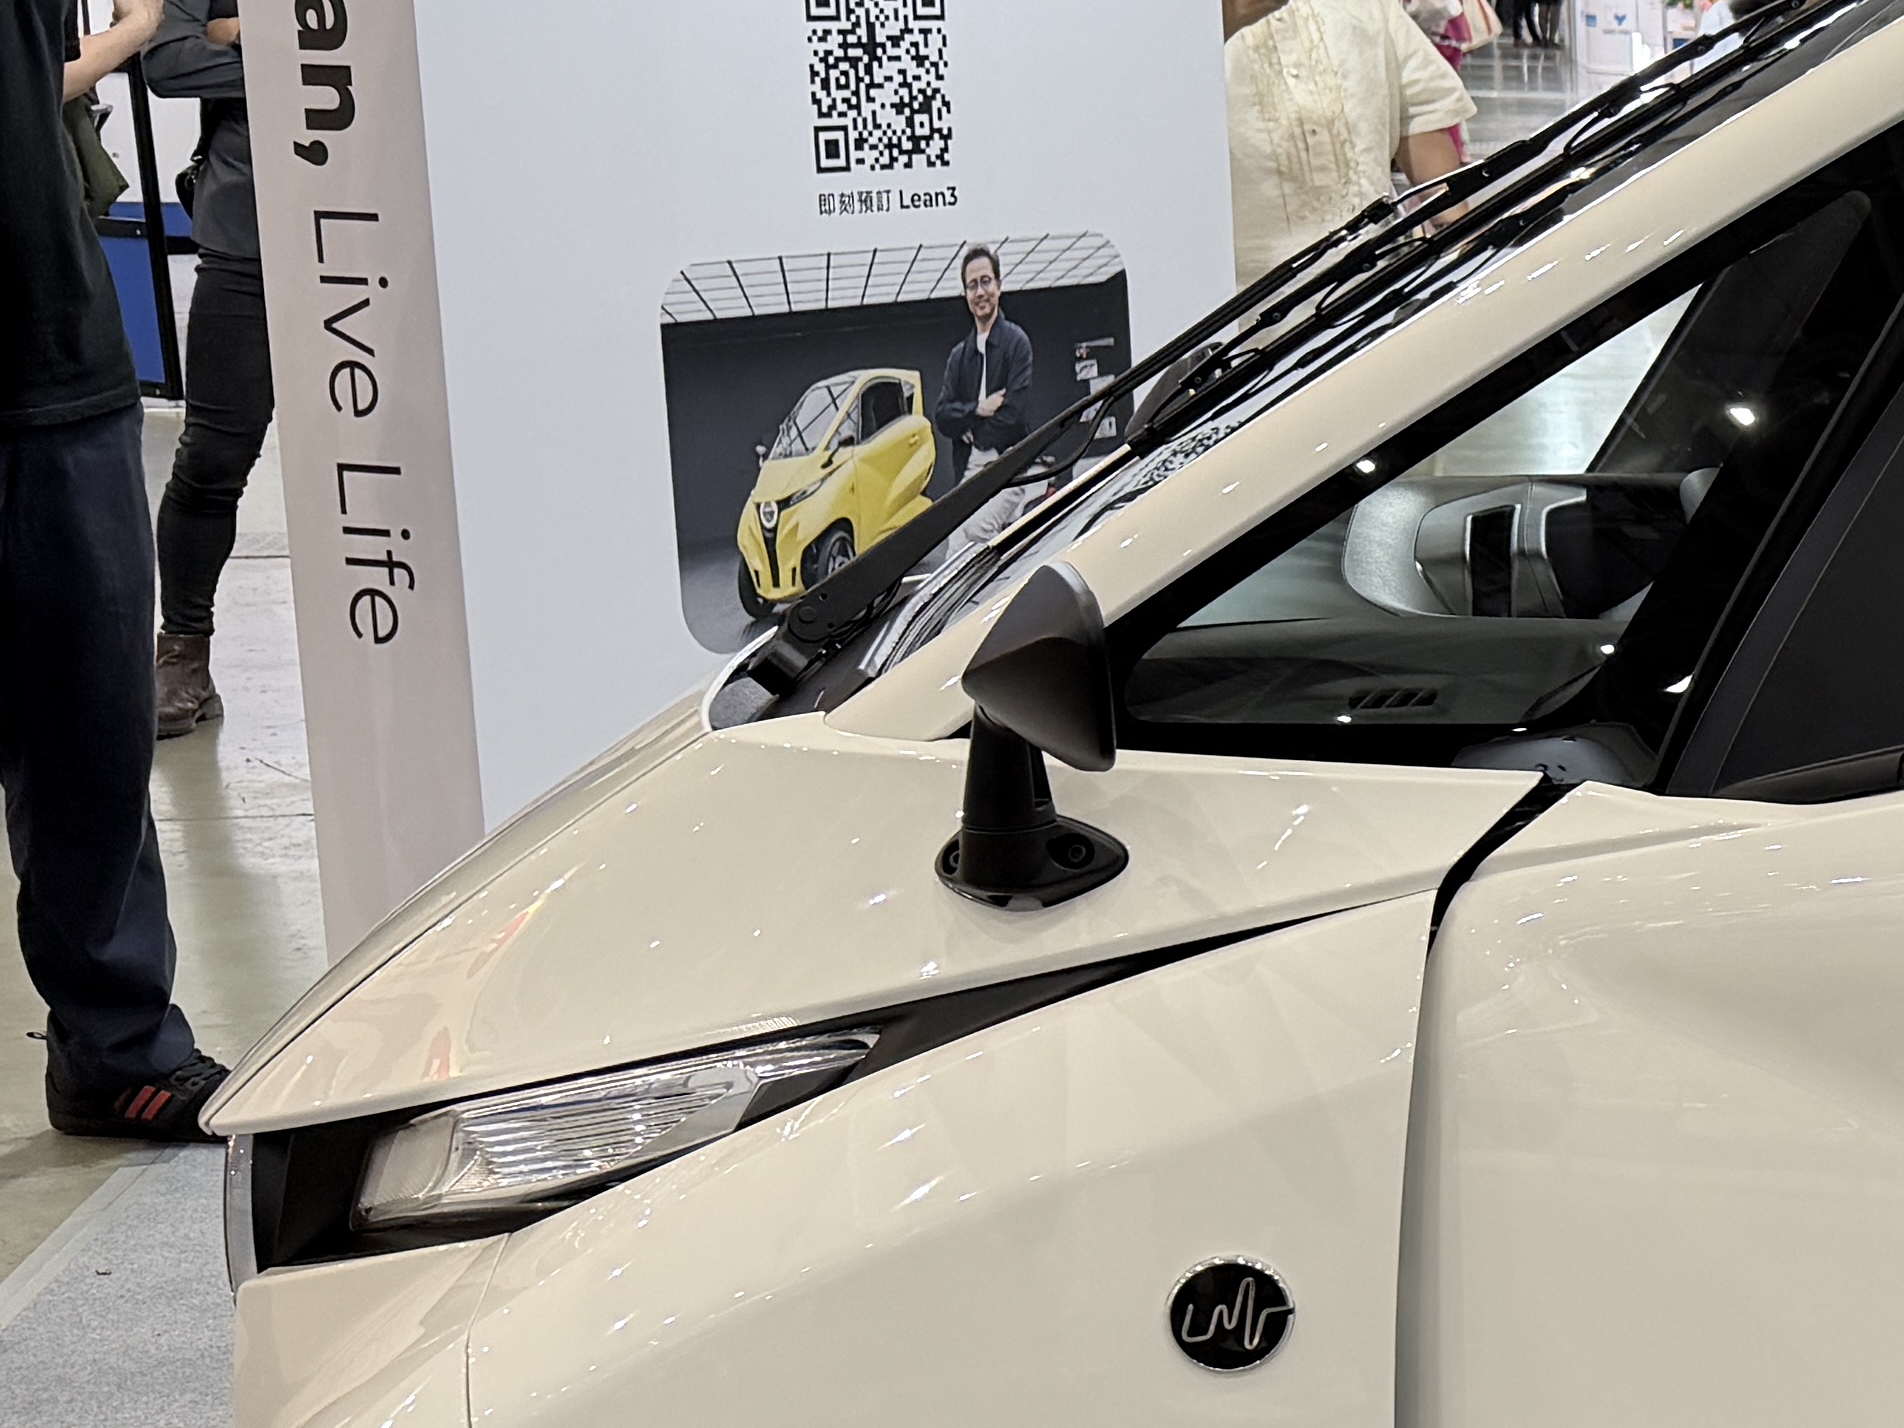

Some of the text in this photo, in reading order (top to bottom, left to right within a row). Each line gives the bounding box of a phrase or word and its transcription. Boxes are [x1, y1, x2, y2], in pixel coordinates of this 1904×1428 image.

[818, 186, 958, 217] 即刻預訂 Lean3
[313, 208, 390, 419] Live
[335, 461, 416, 646] Life
